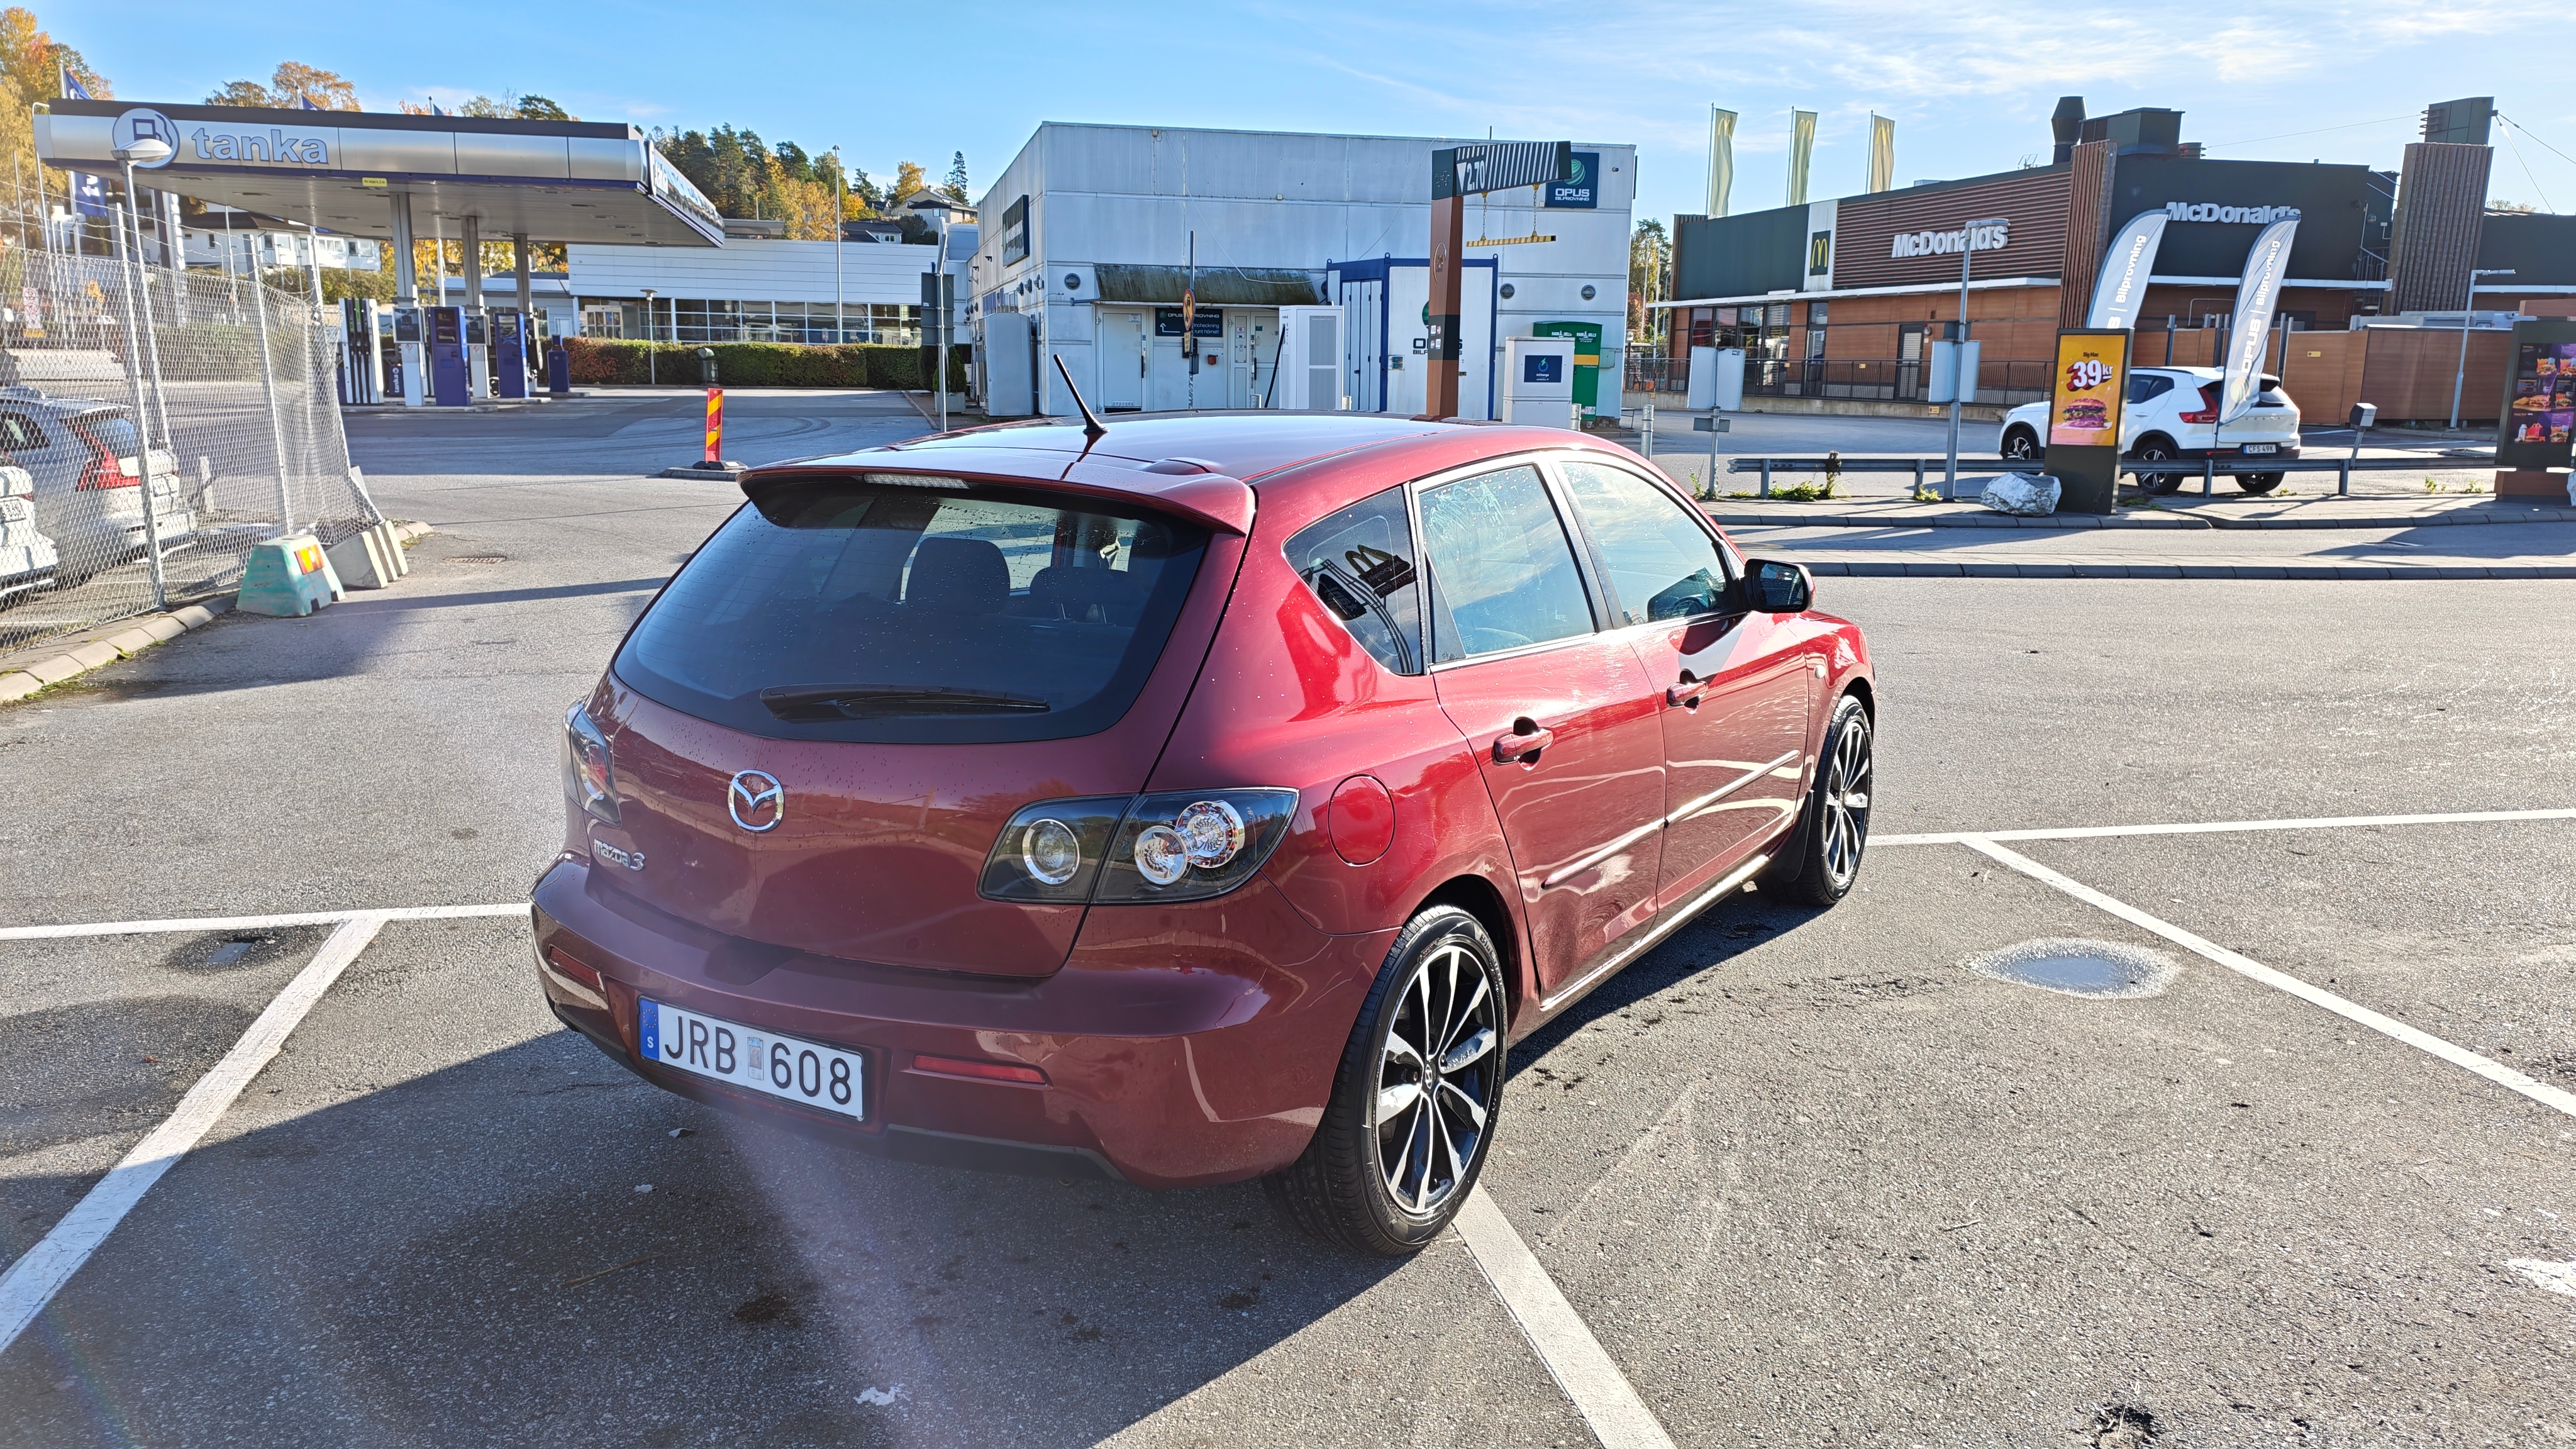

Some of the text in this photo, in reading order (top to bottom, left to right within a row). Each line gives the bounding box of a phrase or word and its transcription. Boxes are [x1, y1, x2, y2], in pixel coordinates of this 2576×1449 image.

[191, 127, 329, 164] tanka
[1555, 188, 1590, 197] OPUS
[2166, 202, 2301, 224] McDonald's
[1891, 225, 2009, 258] McDonald's
[2115, 235, 2147, 303] Bilprovning
[2241, 240, 2280, 374] OPUS Bilprovning
[2073, 360, 2101, 387] 39
[647, 1035, 655, 1049] S
[664, 1015, 852, 1106] JRB 608
